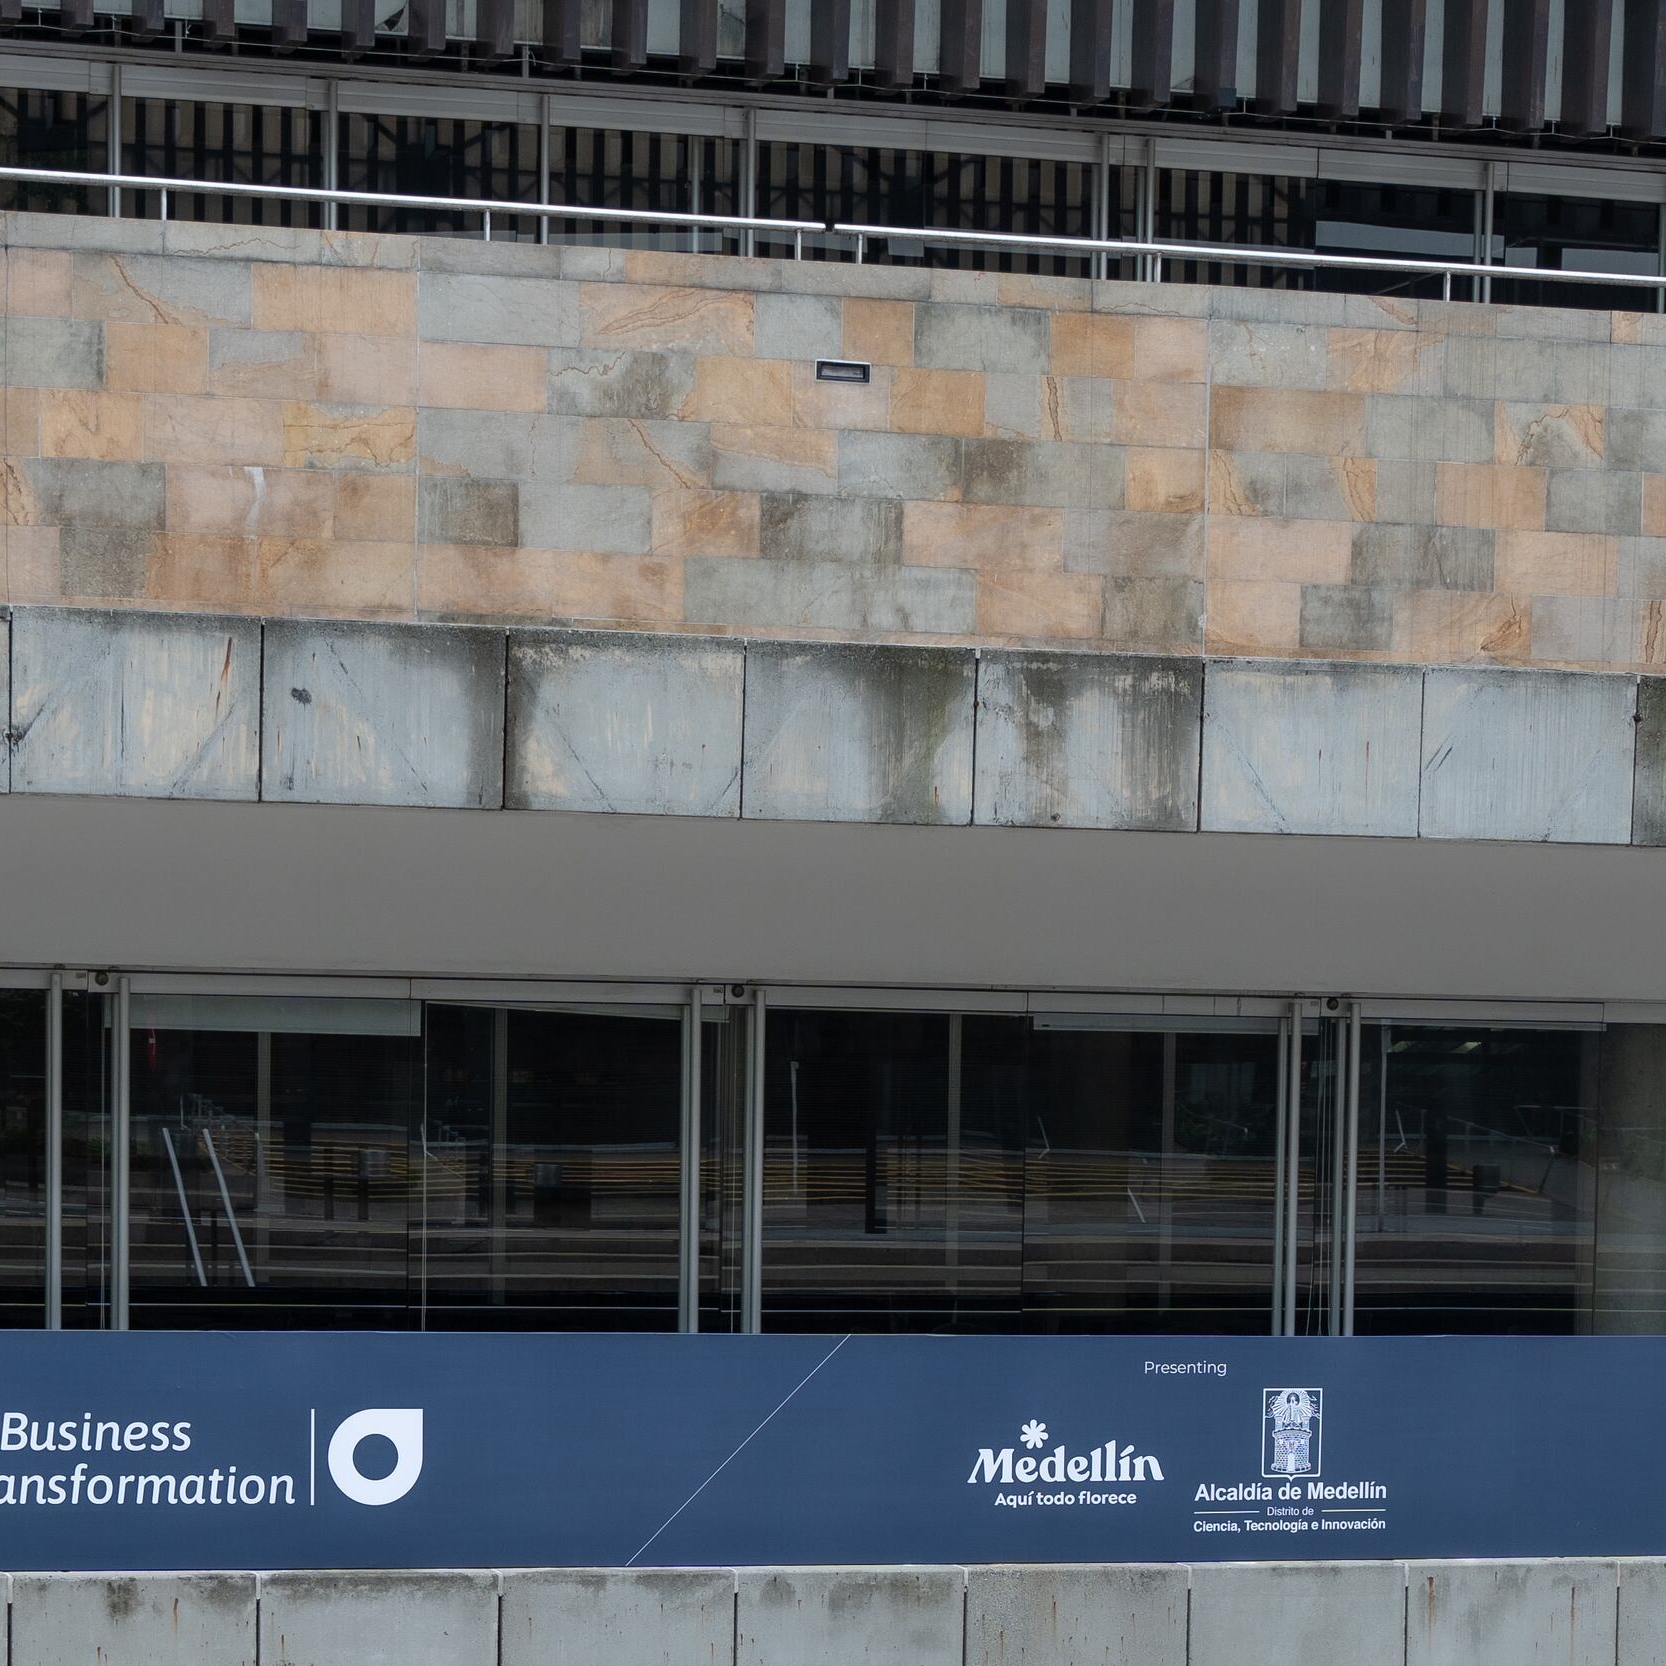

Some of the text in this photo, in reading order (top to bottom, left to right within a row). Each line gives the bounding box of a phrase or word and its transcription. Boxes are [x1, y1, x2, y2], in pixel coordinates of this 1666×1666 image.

[1144, 1360, 1228, 1377] Presenting
[1, 1412, 192, 1452] Business
[968, 1439, 1165, 1484] Medellín
[994, 1490, 1137, 1508] Aquí todo florece
[1194, 1480, 1387, 1502] Alcaldía de Medellín
[1266, 1506, 1315, 1517] Distrito de
[1193, 1517, 1386, 1534] Ciencia, Tecnología e Innovación
